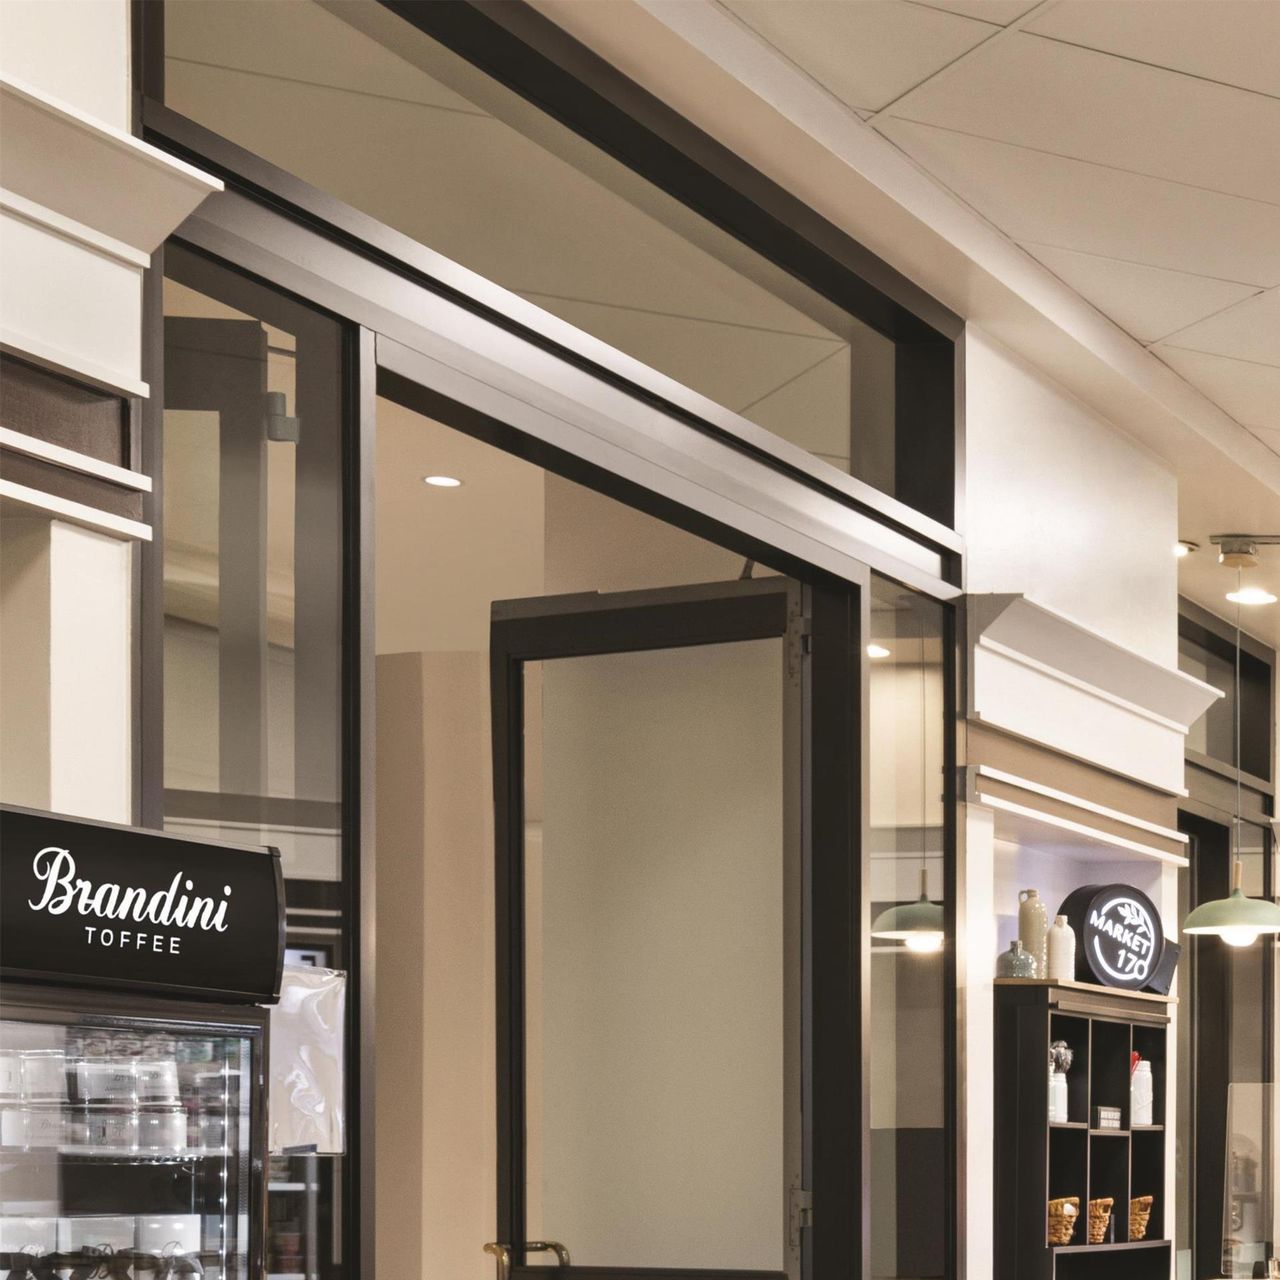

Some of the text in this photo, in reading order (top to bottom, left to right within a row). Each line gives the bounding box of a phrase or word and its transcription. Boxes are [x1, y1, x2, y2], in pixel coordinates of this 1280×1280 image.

[28, 847, 232, 932] Brandini
[85, 927, 181, 954] TOFFEE
[1090, 910, 1151, 955] MARKET
[1117, 949, 1148, 980] 170
